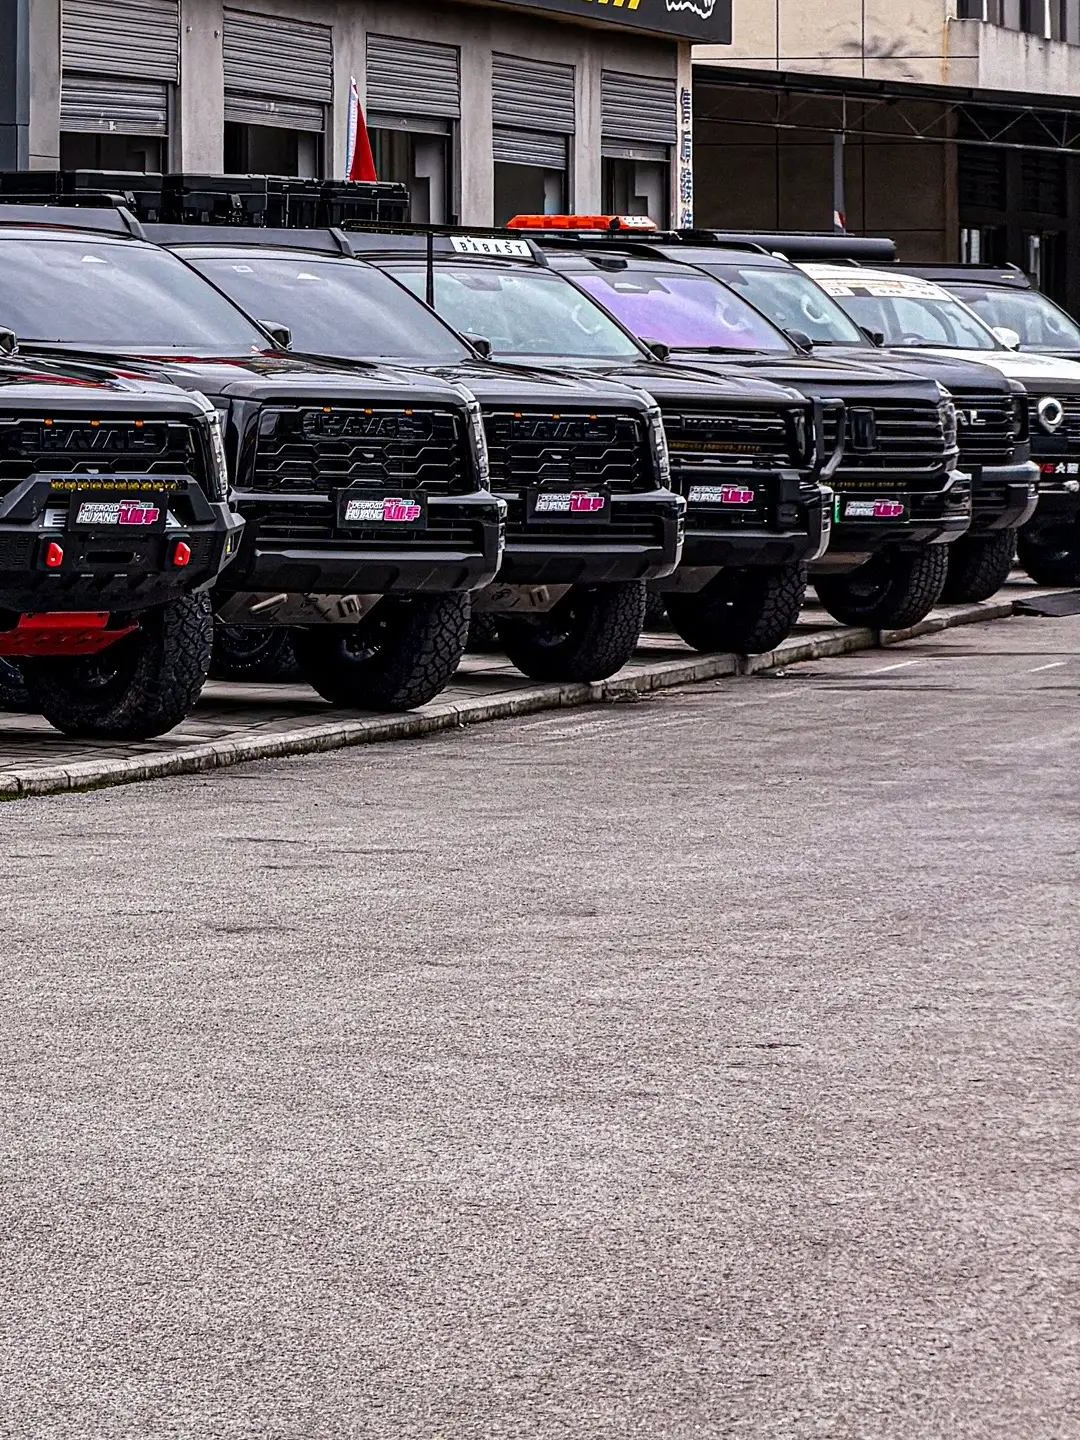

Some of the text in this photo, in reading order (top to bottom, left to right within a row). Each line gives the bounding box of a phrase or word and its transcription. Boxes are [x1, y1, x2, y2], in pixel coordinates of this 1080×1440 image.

[84, 503, 120, 512] OFFROAD
[77, 511, 119, 523] HUYANG
[345, 509, 384, 520] HUYANG
